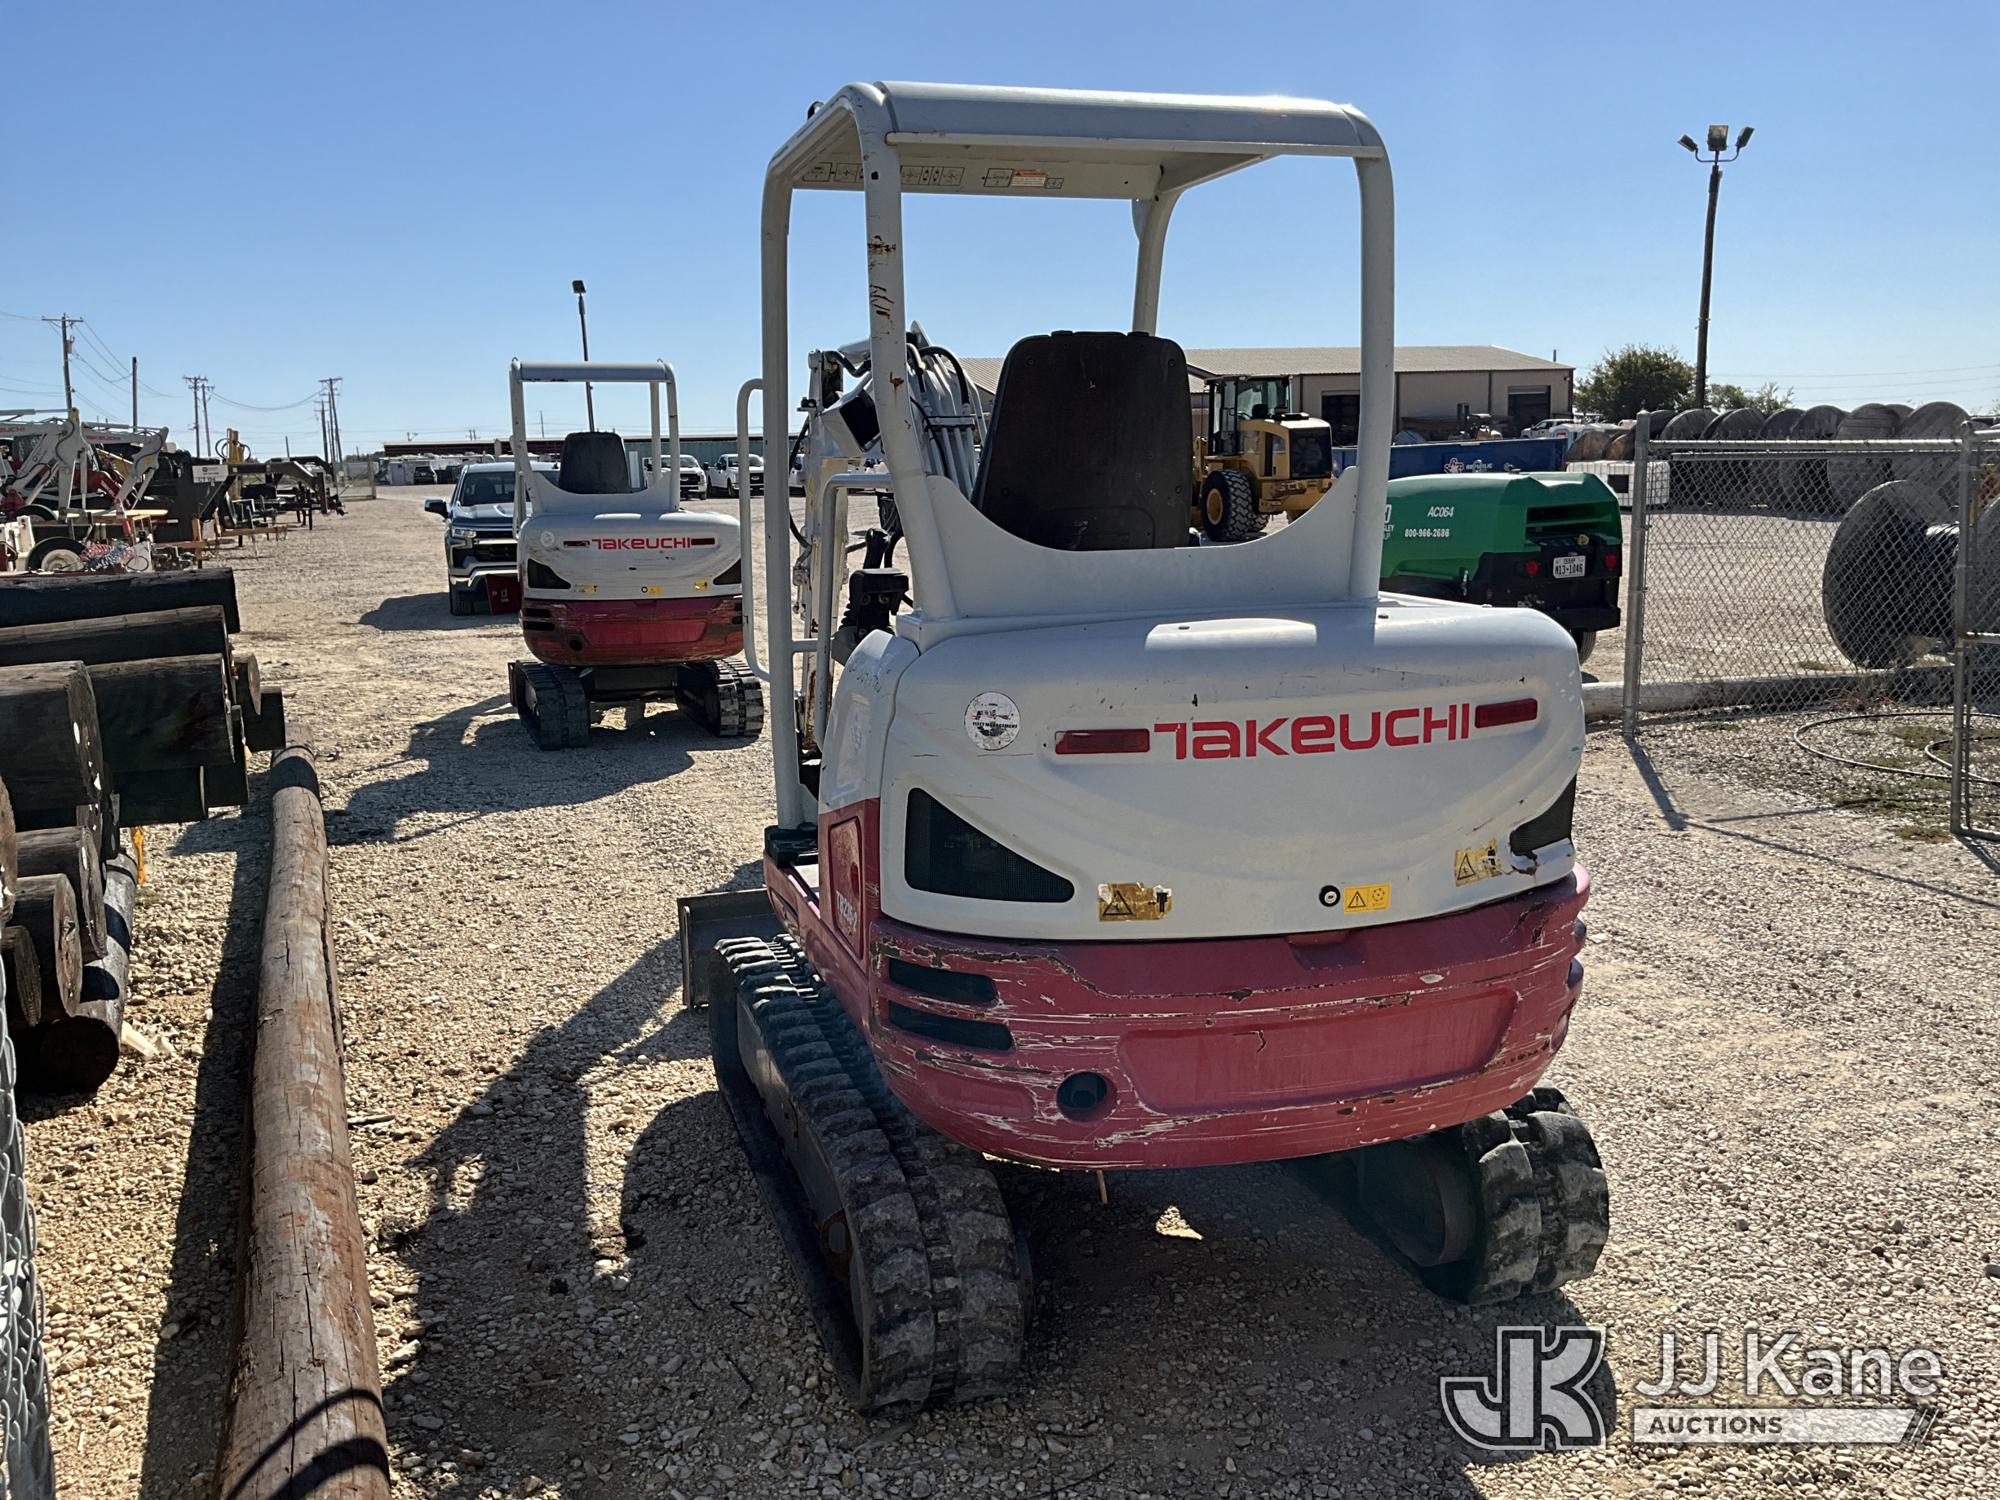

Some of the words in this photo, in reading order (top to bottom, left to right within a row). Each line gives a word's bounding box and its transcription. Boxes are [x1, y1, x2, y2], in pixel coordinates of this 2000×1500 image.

[1427, 506, 1455, 518] AC064
[592, 537, 691, 550] TAKEUCHI
[1154, 703, 1470, 761] TAKEUCHI
